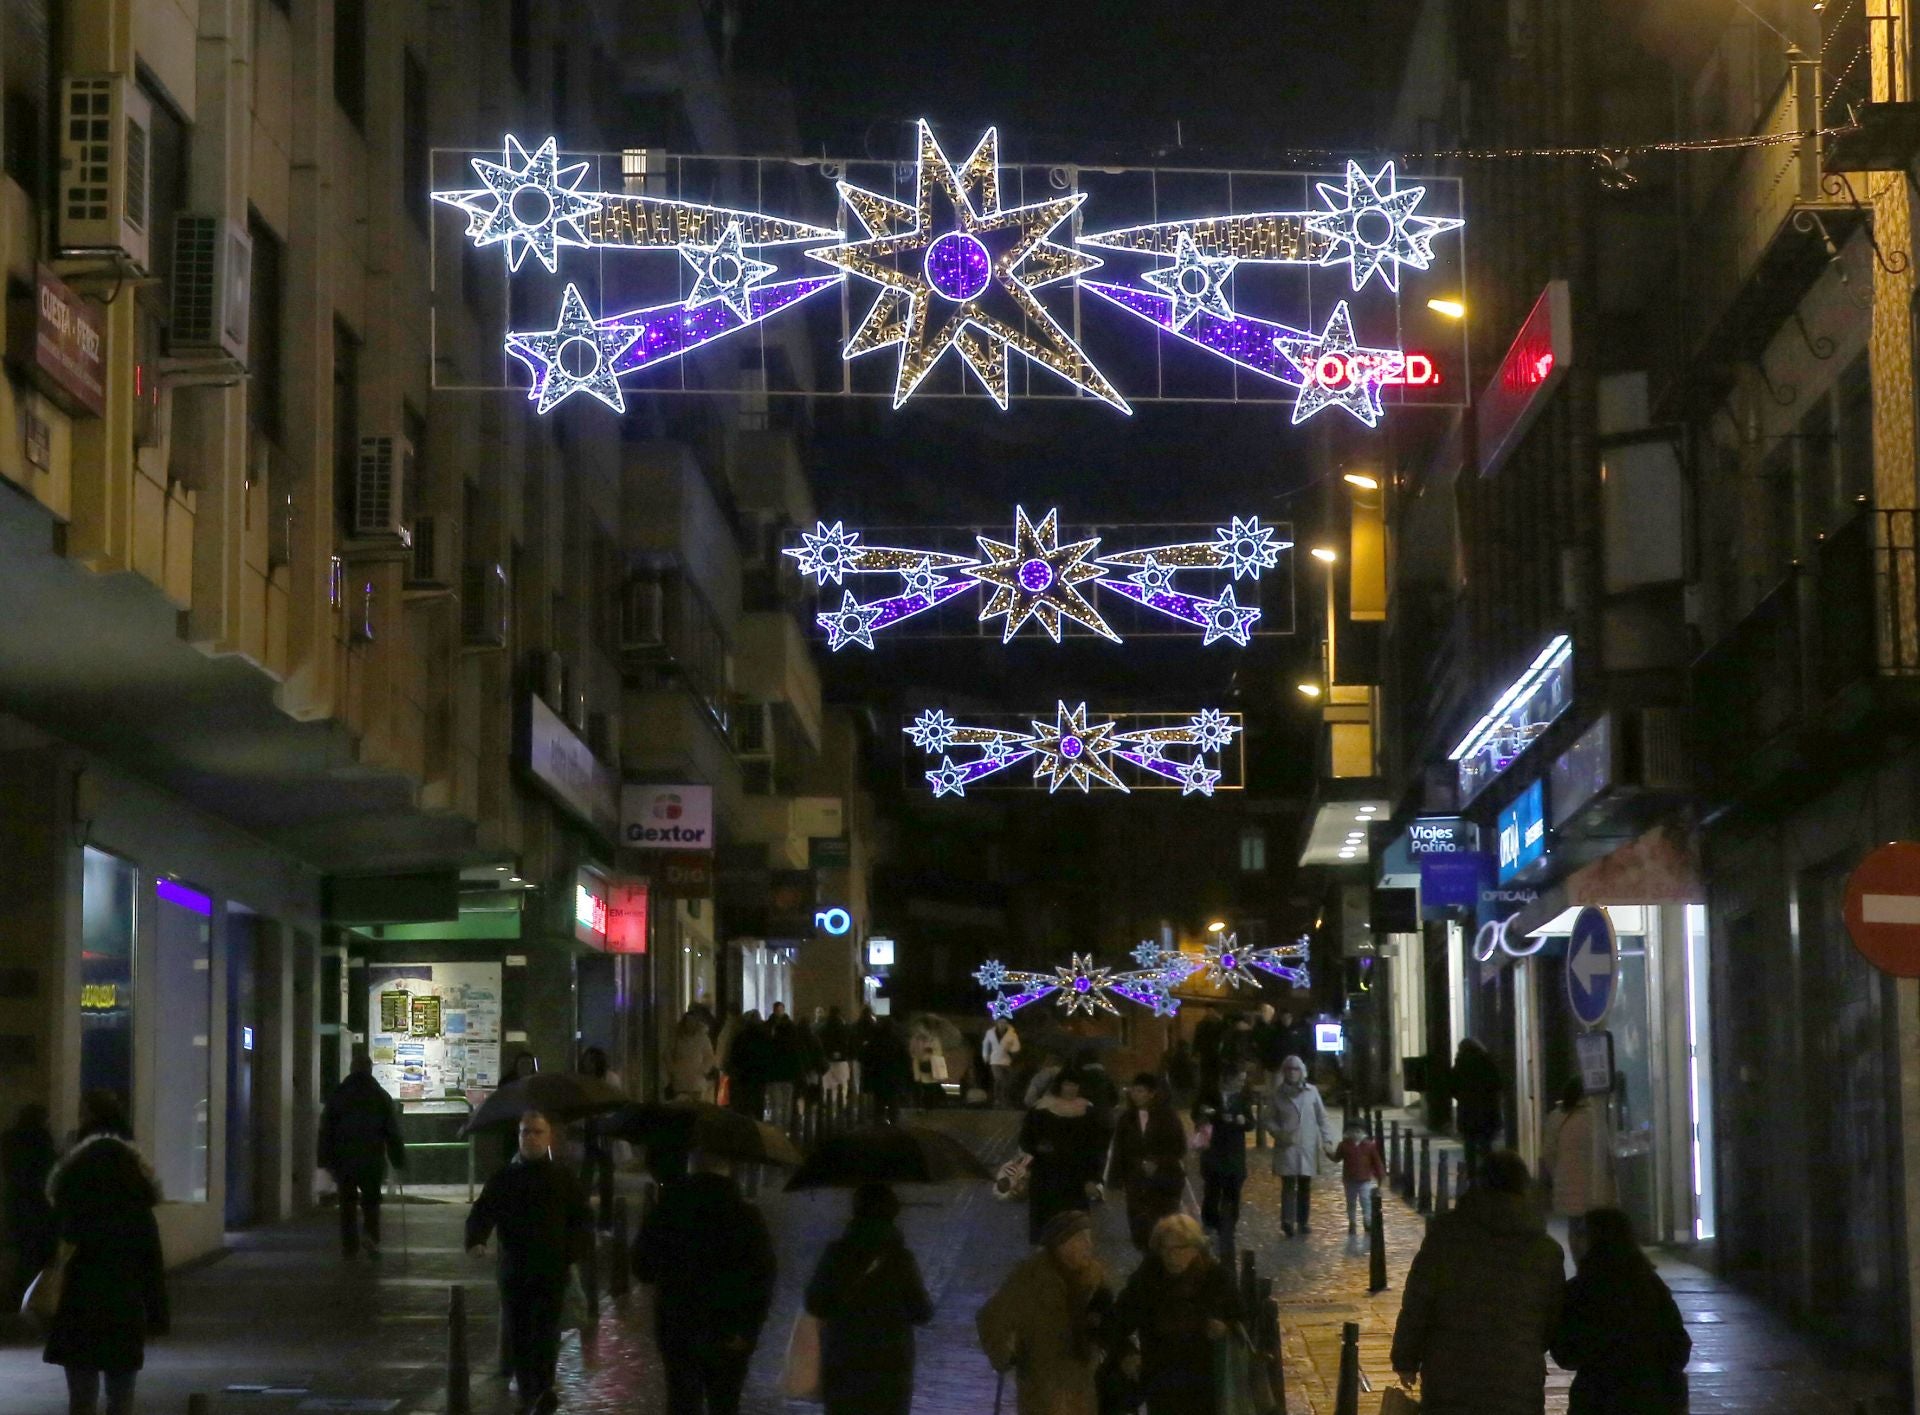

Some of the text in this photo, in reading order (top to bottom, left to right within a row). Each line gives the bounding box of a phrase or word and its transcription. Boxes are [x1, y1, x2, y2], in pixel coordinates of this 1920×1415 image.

[626, 823, 705, 842] Gextor
[1409, 826, 1454, 842] Viajes
[1411, 840, 1456, 853] Patiño
